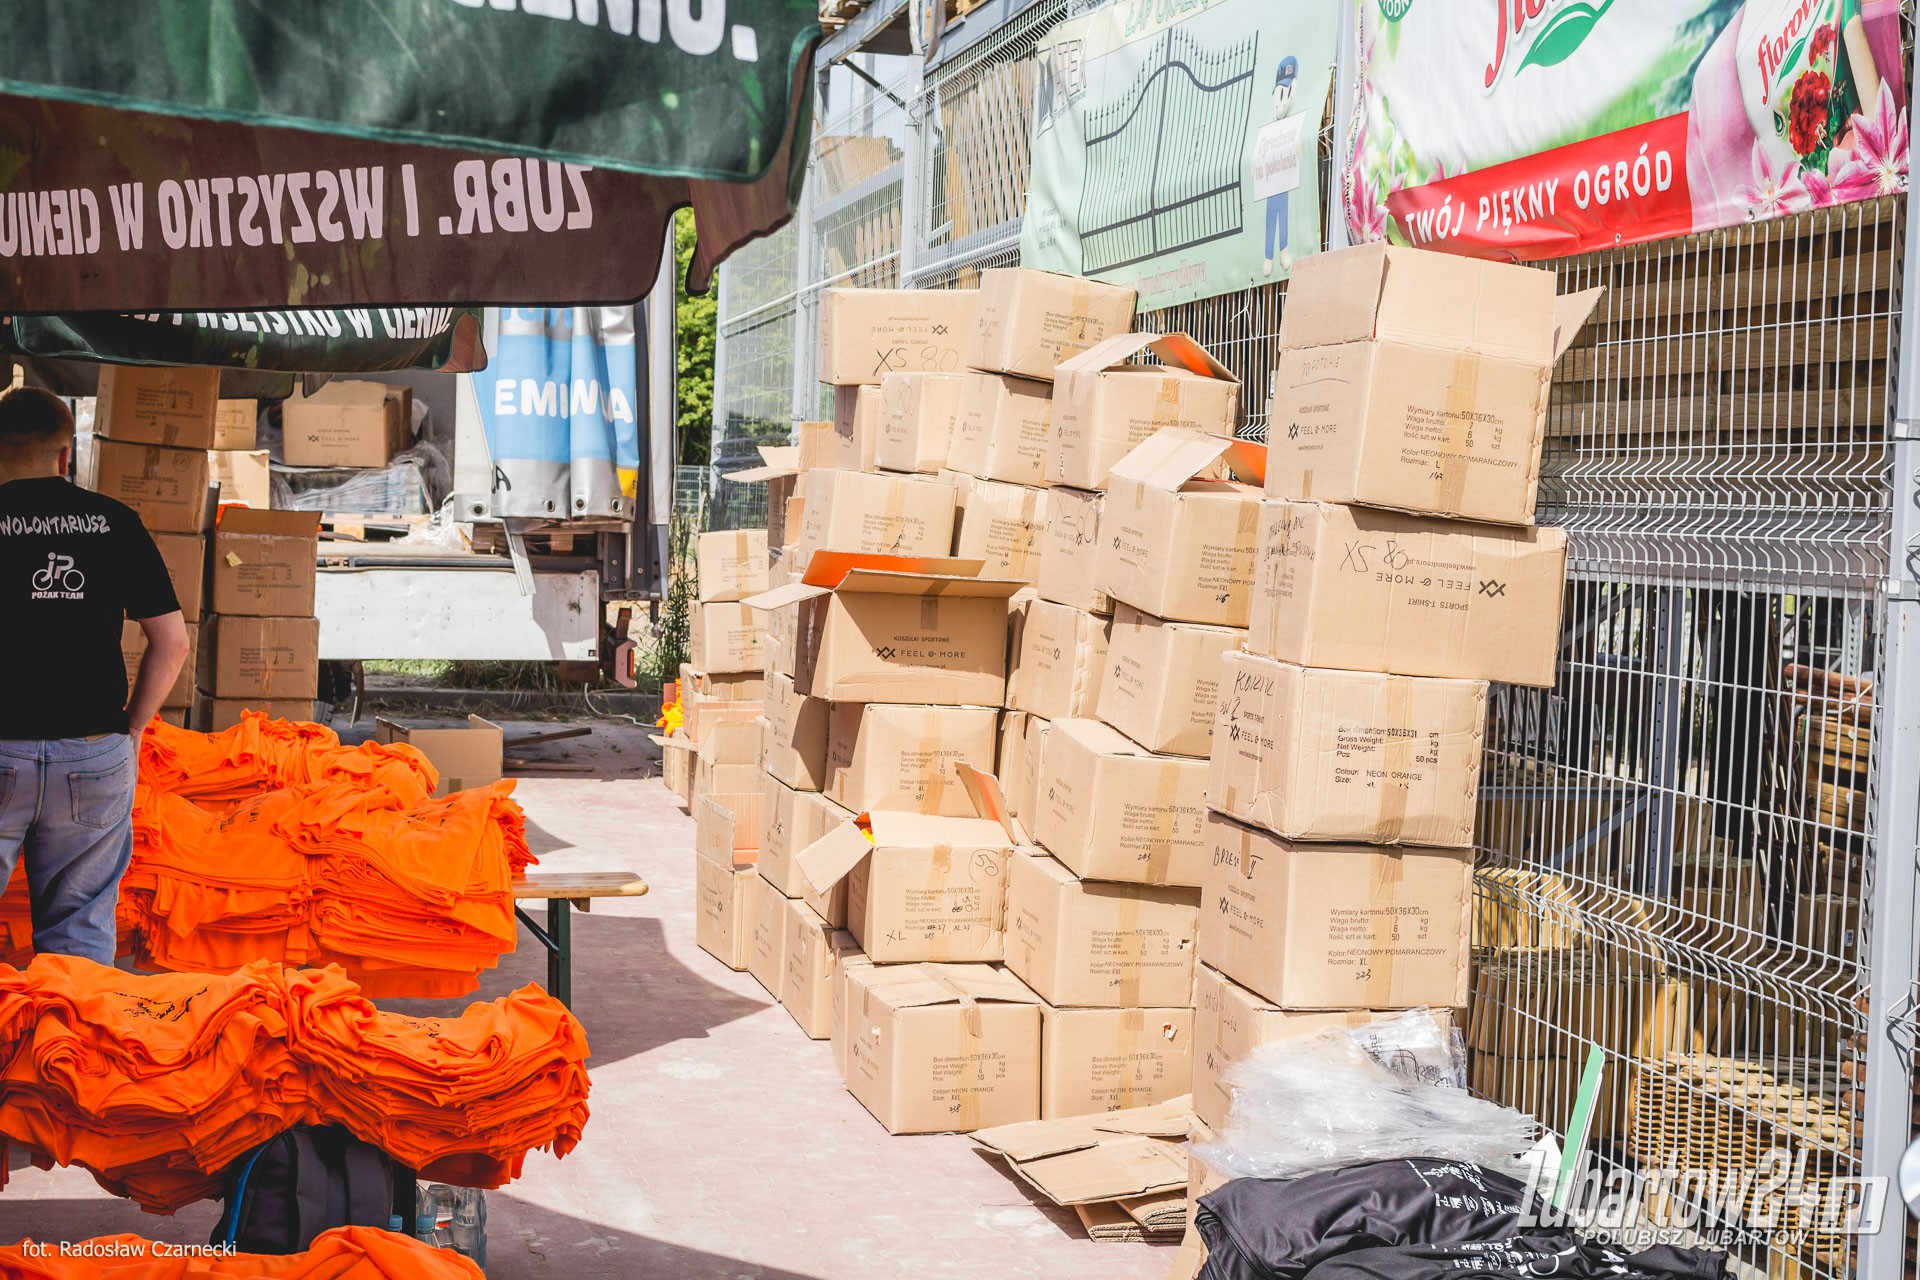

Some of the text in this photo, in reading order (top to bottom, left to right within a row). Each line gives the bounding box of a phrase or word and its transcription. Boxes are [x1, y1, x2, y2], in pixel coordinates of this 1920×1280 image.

[1404, 143, 1673, 246] TWÓJ PIĘKNY OGRÓD
[872, 345, 958, 376] XS 80
[1407, 405, 1436, 417] Wymiary
[1406, 414, 1424, 423] Waga
[1426, 416, 1445, 426] brutto:
[1405, 423, 1423, 432] Waga
[1425, 426, 1443, 434] netto:
[1404, 431, 1419, 439] Ilość
[1465, 440, 1473, 448] 50
[1401, 456, 1428, 466] Rozmiar:
[1340, 540, 1376, 573] XS
[1384, 540, 1410, 570] 80
[1375, 572, 1414, 586] MORE
[1438, 578, 1471, 591] FEEL
[61, 591, 84, 600] TEAM
[1408, 598, 1469, 611] SPORTS T-SHIRT
[1242, 731, 1274, 749] FEEL MORE
[1430, 748, 1438, 756] kg
[1366, 770, 1387, 778] NEON
[1391, 772, 1422, 780] ORANGE
[1330, 908, 1359, 917] Wymiary
[1330, 917, 1349, 925] Waga
[1330, 925, 1348, 933] Waga
[1420, 925, 1428, 933] kg
[1386, 948, 1446, 956] POMARAŃCZOWY
[1360, 958, 1368, 966] XL
